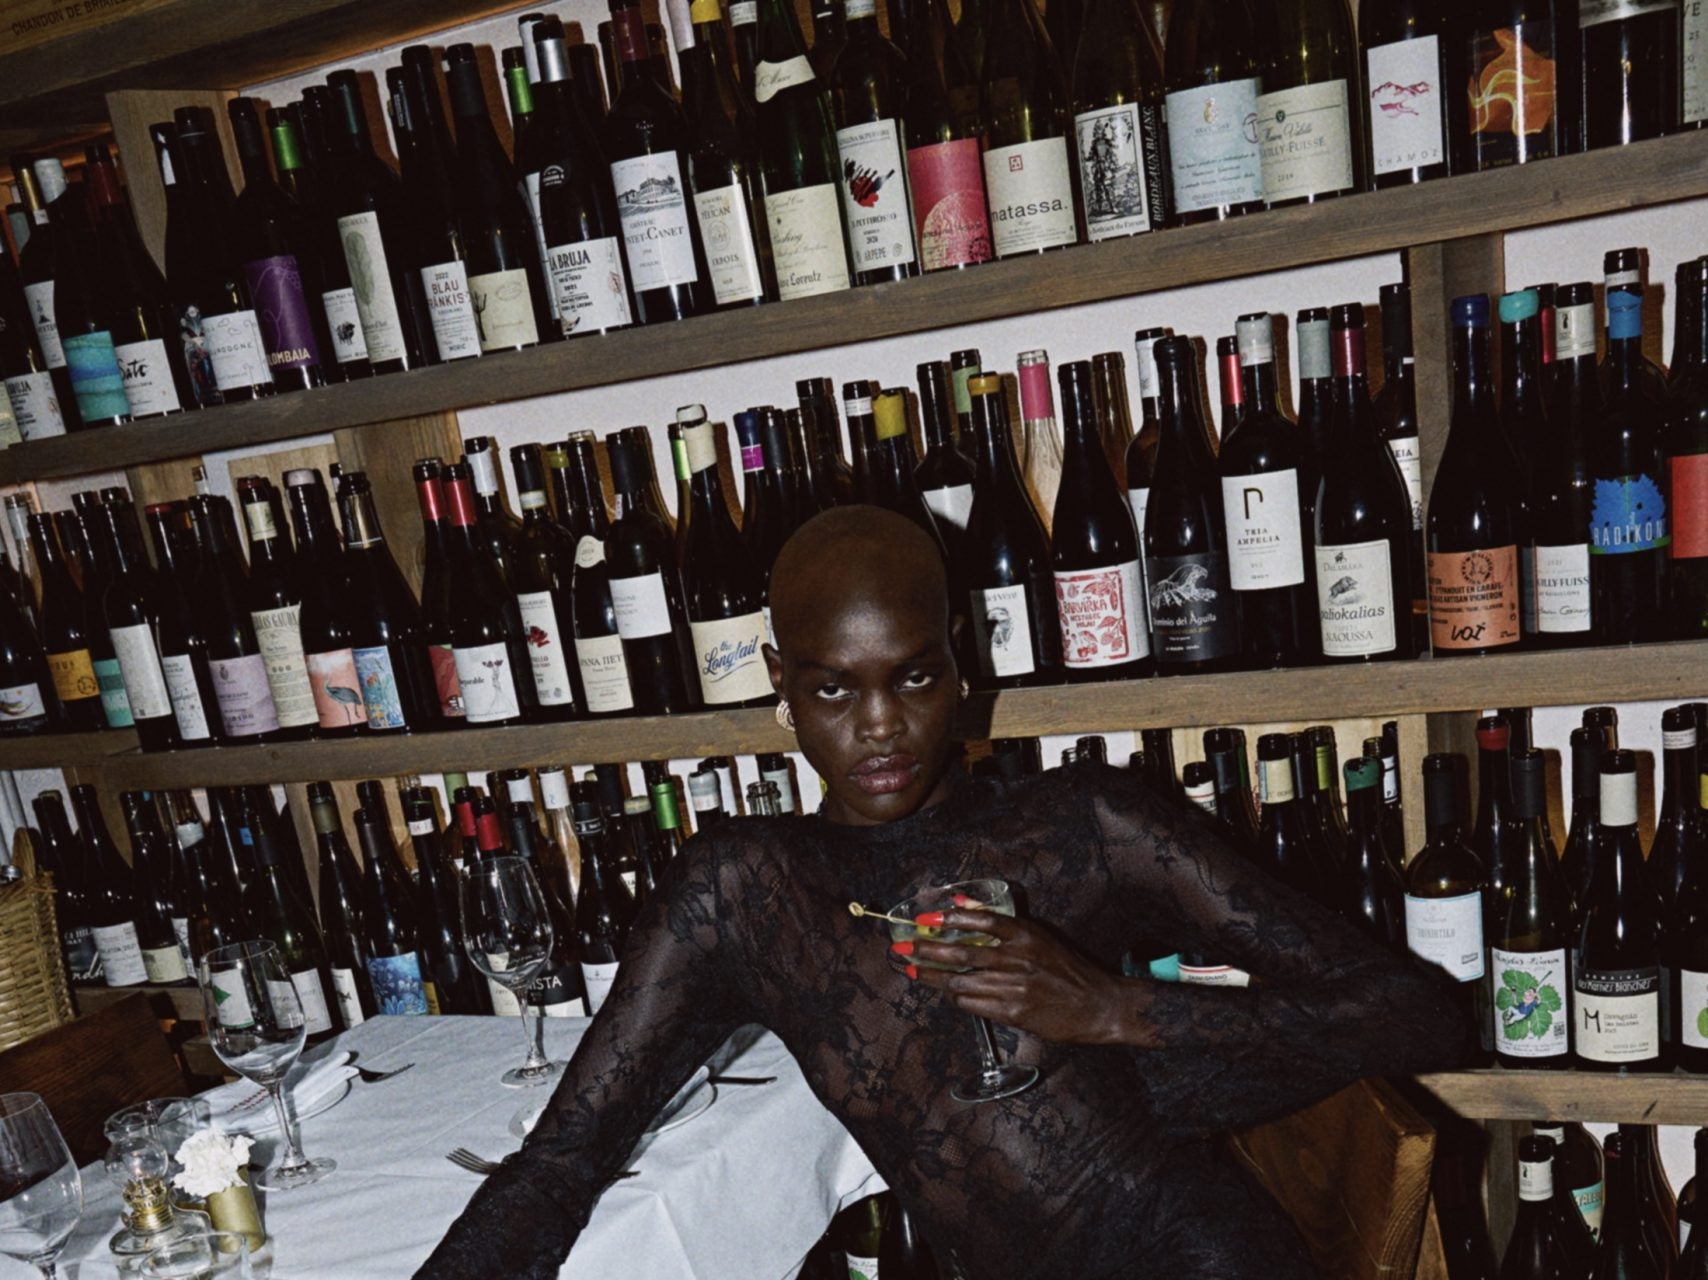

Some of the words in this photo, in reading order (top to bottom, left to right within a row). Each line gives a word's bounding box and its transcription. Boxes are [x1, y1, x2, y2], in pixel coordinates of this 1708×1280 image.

[11, 9, 64, 36] CHANDON
[65, 4, 82, 18] DE
[557, 248, 592, 269] BRUJA
[431, 279, 460, 294] BLAU
[1236, 535, 1281, 546] AMPELIA
[1593, 520, 1664, 546] RADIKON
[702, 635, 760, 676] Longtail
[1583, 1007, 1601, 1034] M
